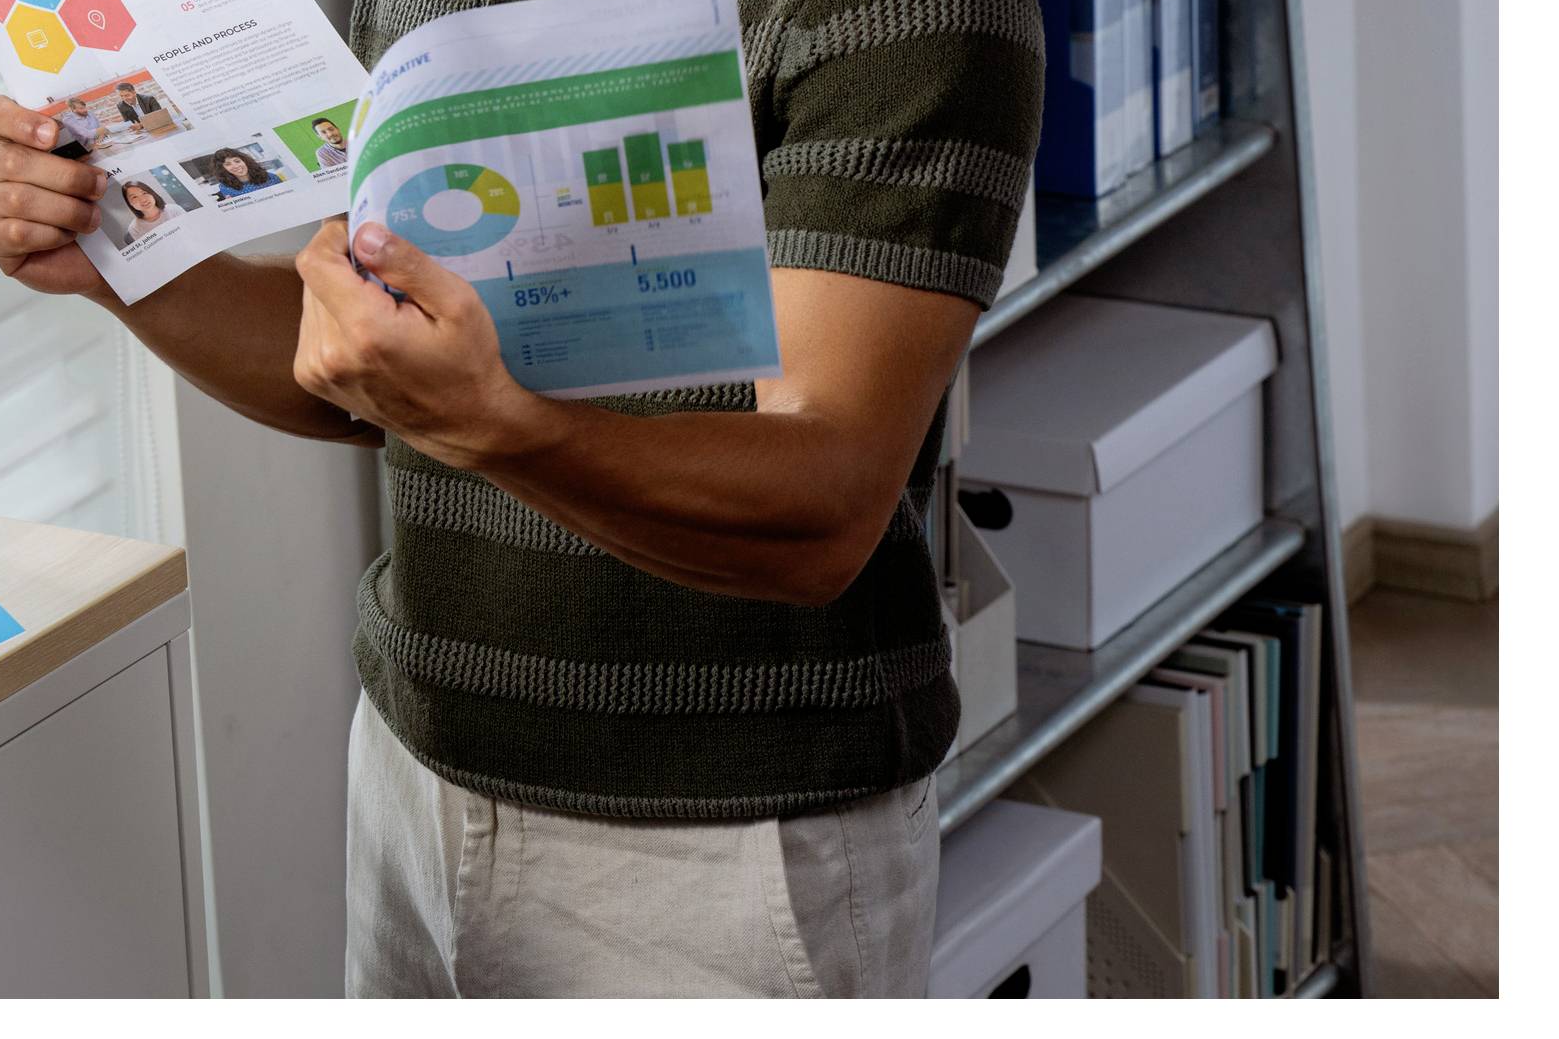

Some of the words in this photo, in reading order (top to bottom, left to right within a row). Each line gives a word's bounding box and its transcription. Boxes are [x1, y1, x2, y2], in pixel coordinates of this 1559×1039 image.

[181, 0, 195, 12] 05
[153, 44, 192, 64] PEOPLE
[192, 36, 213, 50] AND
[213, 19, 258, 41] PROCESS
[514, 285, 572, 308] 85%+
